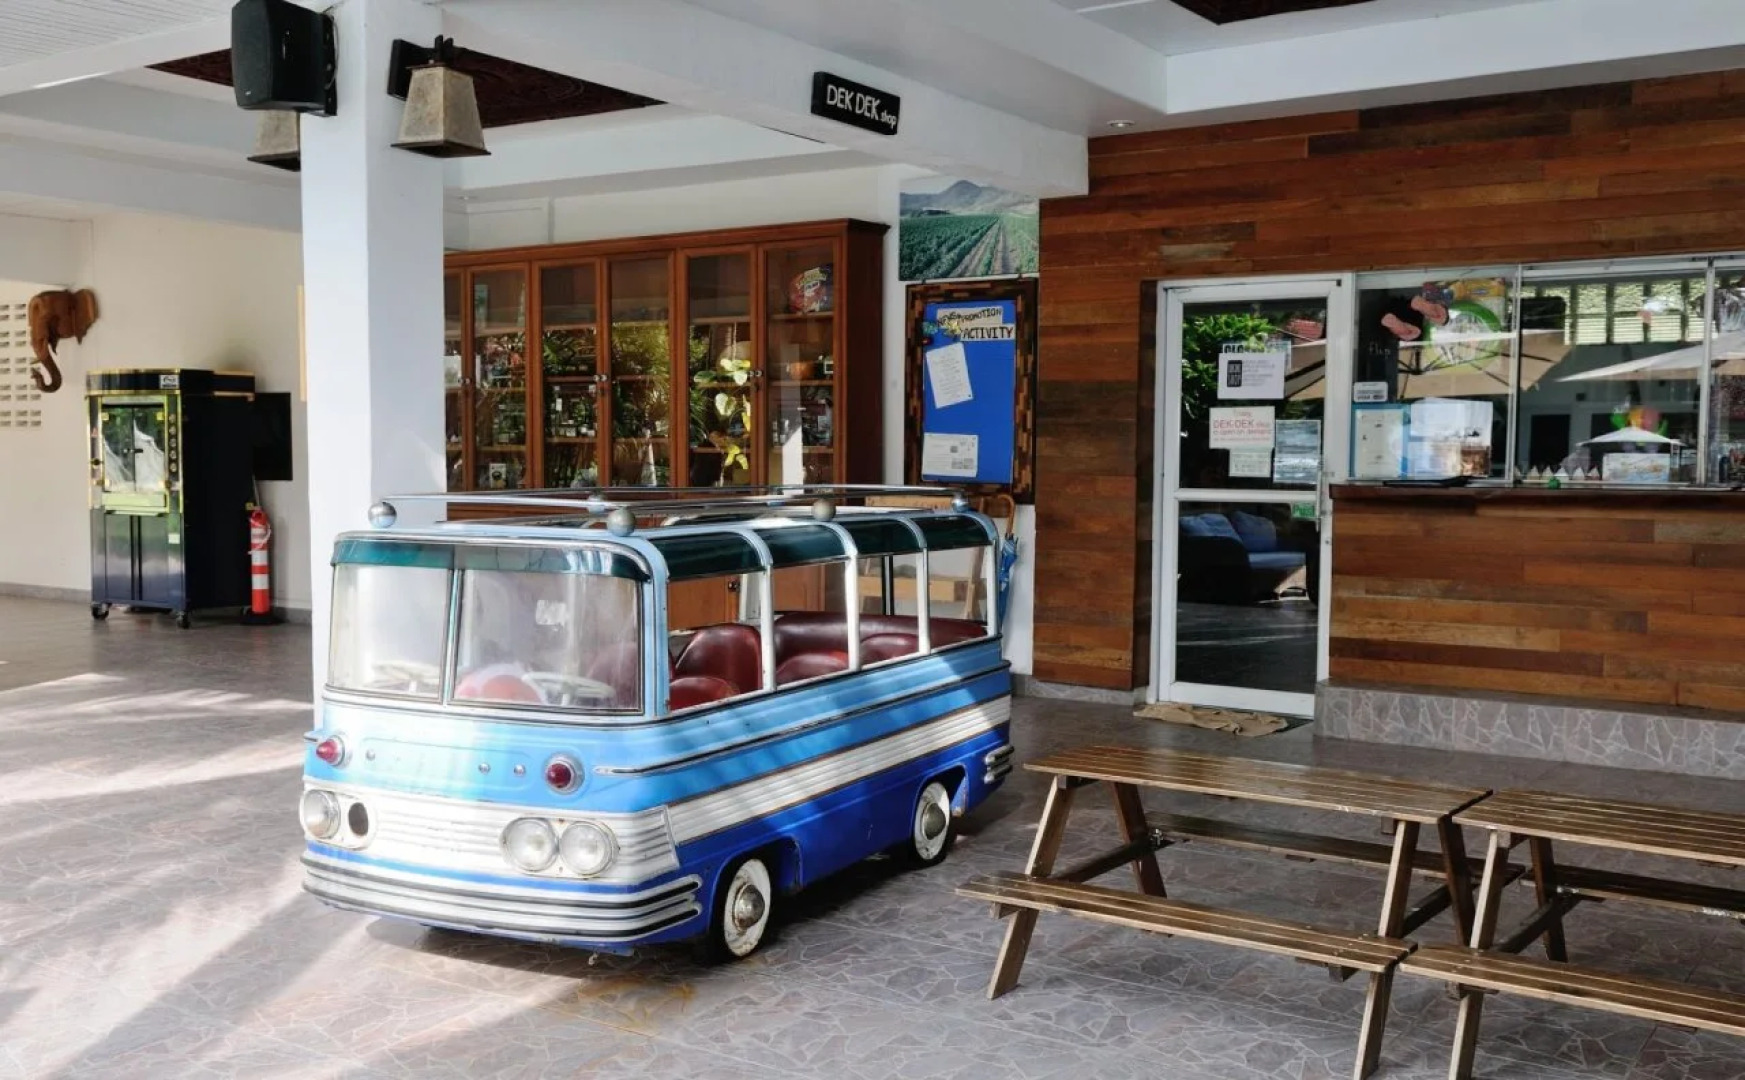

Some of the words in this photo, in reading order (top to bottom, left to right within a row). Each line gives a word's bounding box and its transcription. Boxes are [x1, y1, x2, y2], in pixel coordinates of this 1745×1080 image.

[827, 85, 854, 111] DEK
[855, 93, 881, 120] DEK
[881, 110, 897, 129] shop
[962, 326, 1013, 339] ACTIVITY
